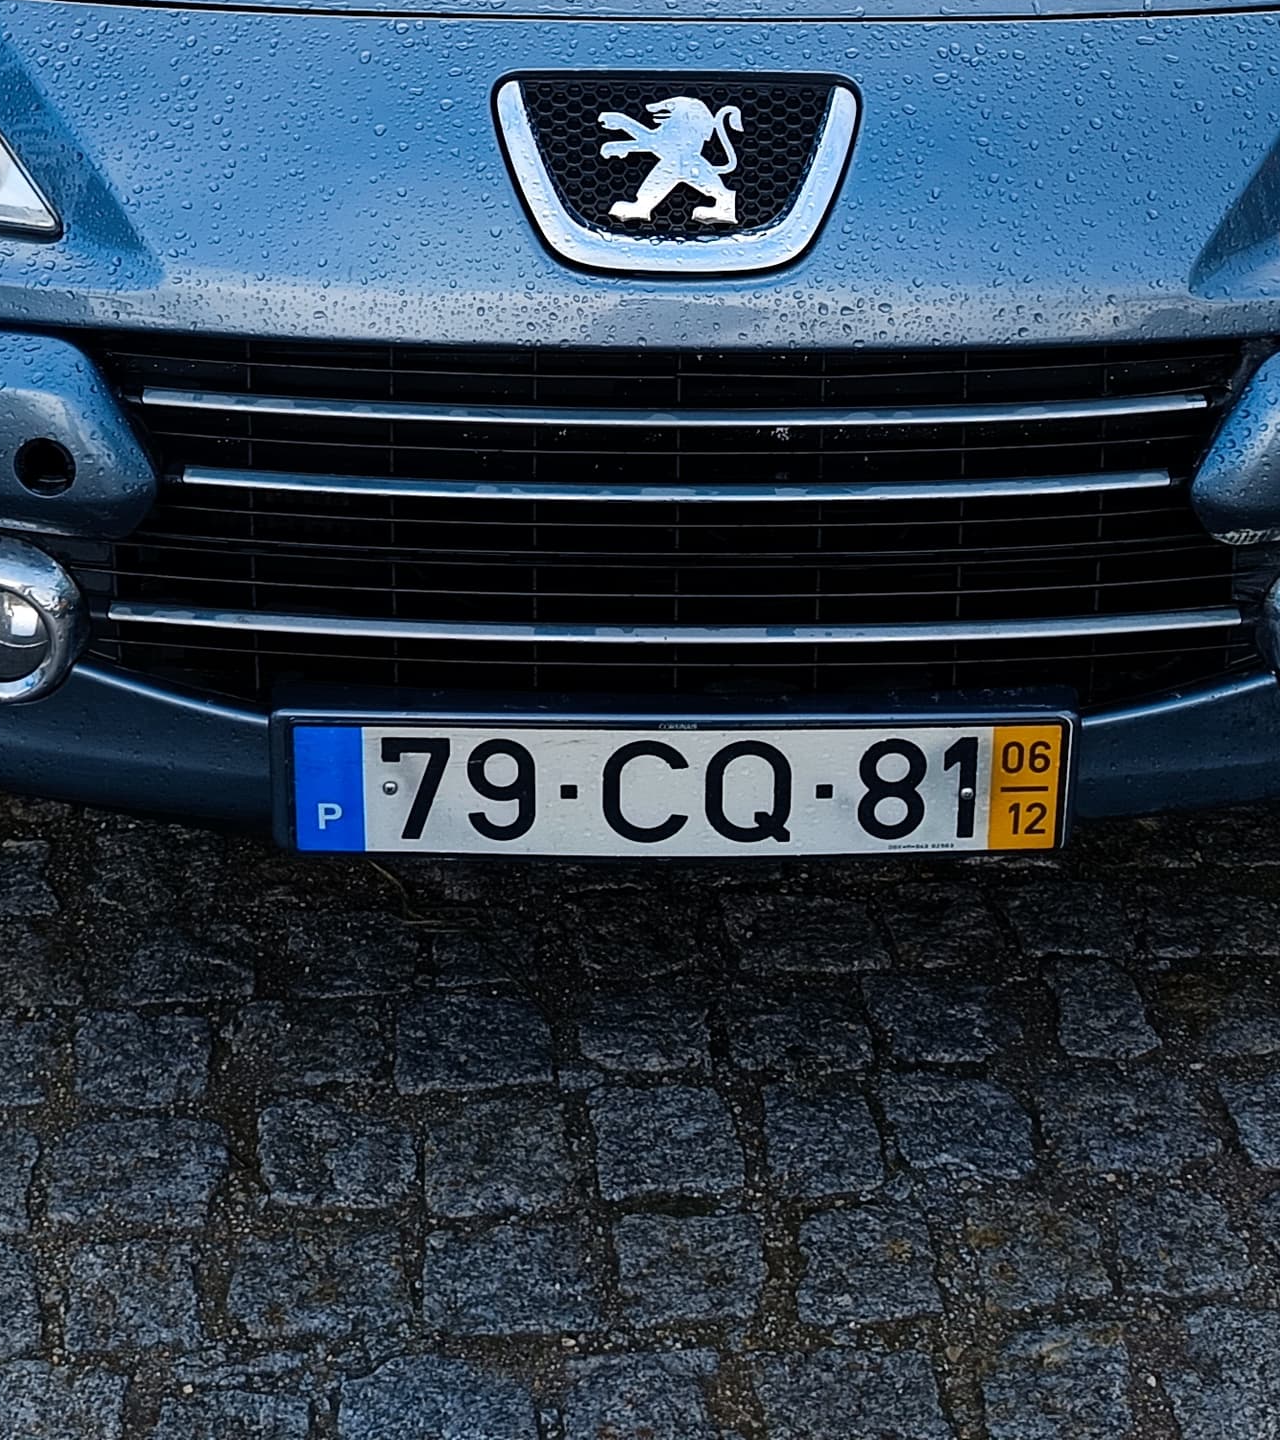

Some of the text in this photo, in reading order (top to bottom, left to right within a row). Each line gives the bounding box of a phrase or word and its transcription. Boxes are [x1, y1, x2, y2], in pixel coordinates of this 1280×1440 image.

[1001, 741, 1051, 773] 06
[318, 803, 342, 829] P
[1008, 802, 1047, 835] 12
